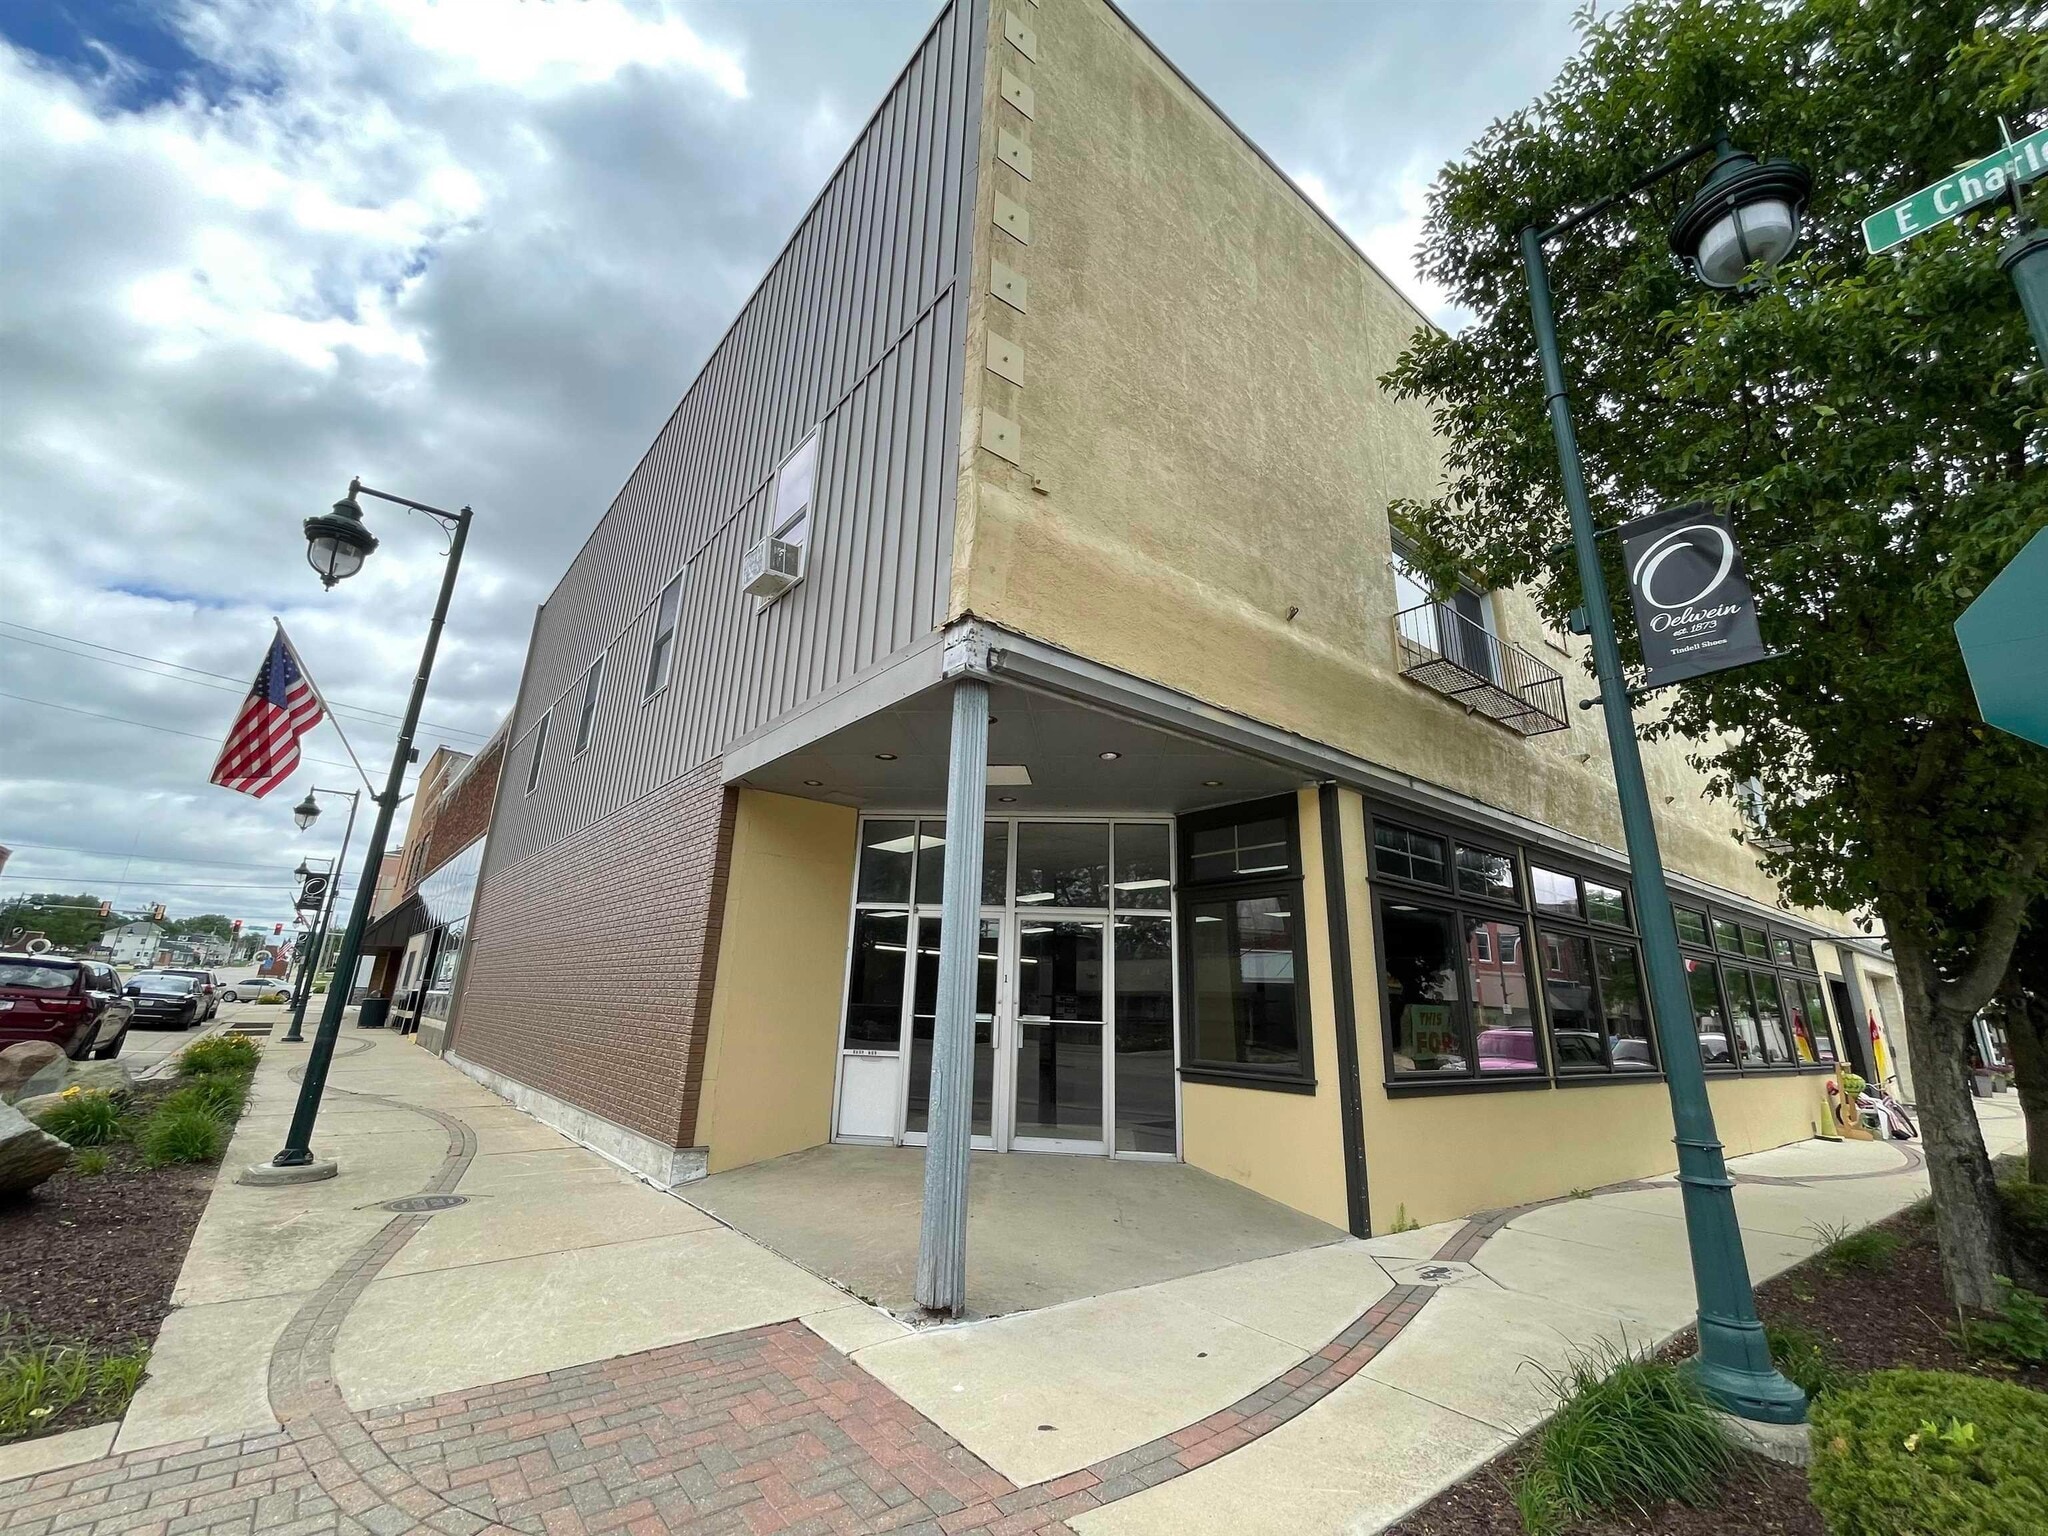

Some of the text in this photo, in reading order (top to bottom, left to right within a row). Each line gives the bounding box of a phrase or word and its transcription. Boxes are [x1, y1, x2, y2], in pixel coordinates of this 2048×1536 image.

[1894, 202, 1919, 235] E
[1650, 603, 1742, 633] Oelwein
[1691, 620, 1718, 633] 1873
[1670, 638, 1728, 655] Tindell Shoes
[1419, 1012, 1443, 1026] THIS
